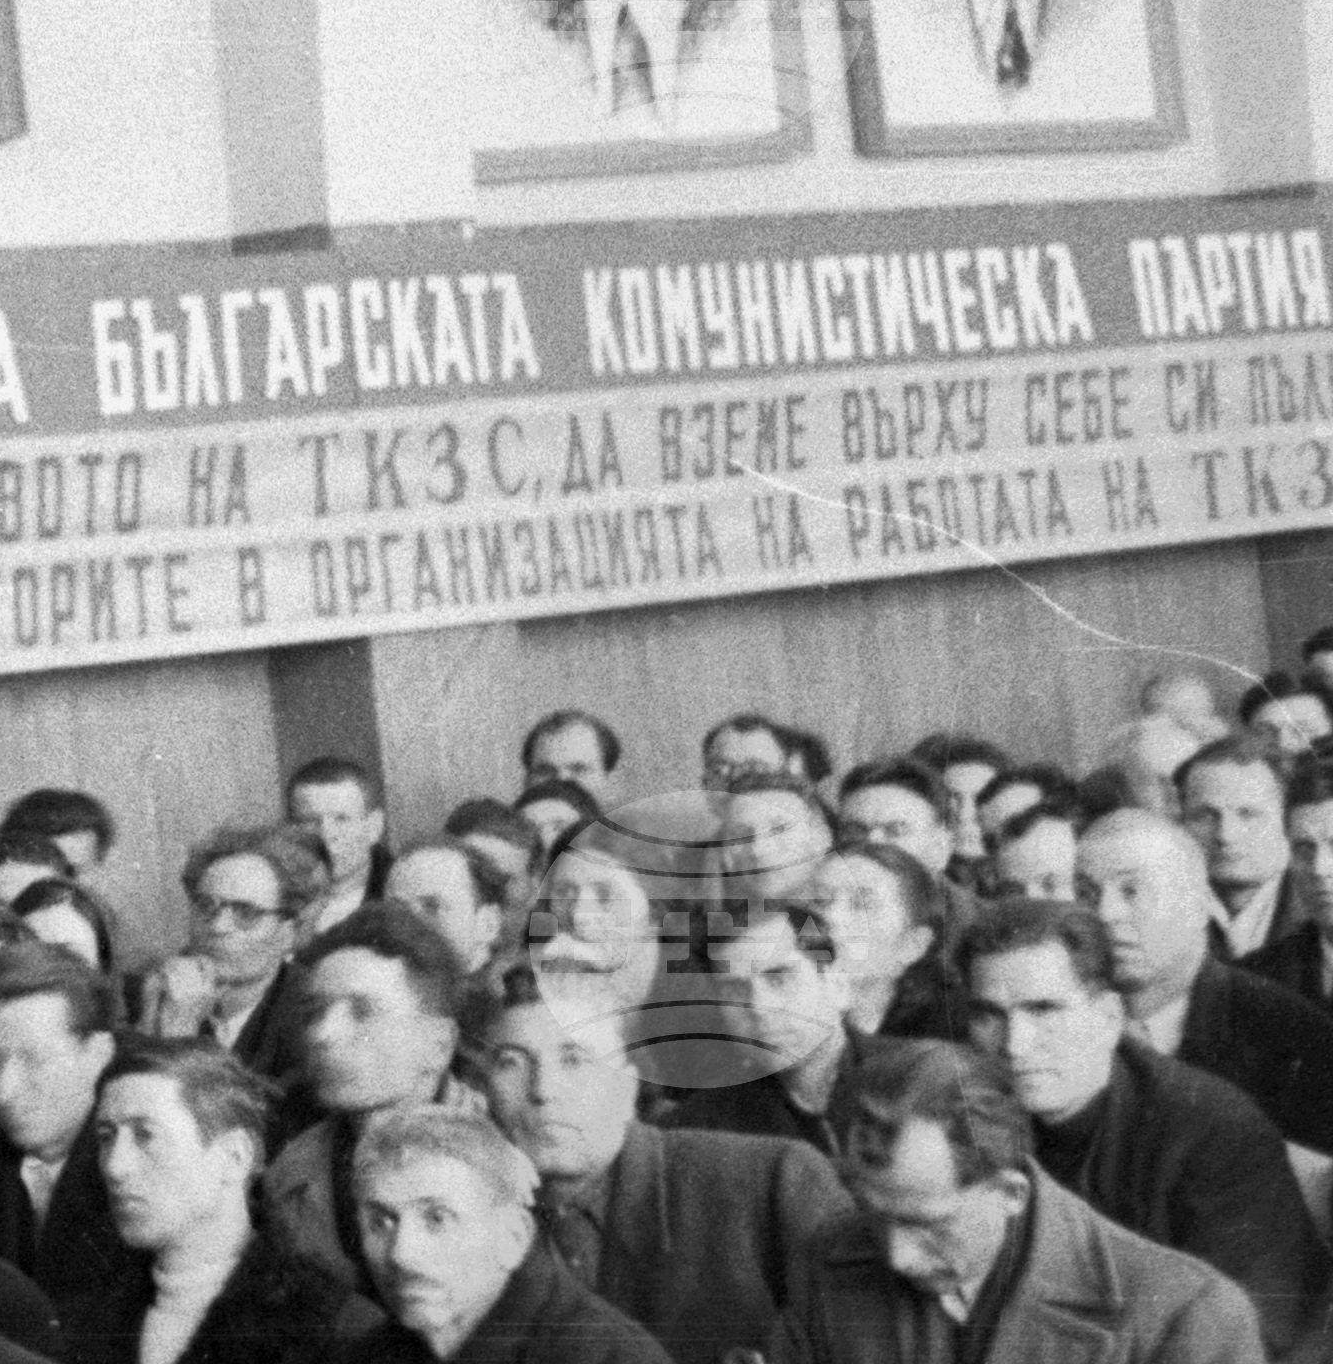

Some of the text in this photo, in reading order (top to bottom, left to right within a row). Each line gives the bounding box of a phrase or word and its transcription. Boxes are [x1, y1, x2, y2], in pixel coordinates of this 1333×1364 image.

[91, 271, 540, 415] БЪЛГАРСКАТА
[583, 242, 1094, 376] КОМУНИСТИЧЕСКА
[1129, 230, 1333, 336] ПАРТИЯ
[187, 444, 253, 530] НА
[561, 407, 624, 497] ДА
[659, 393, 808, 484] ВЗЕМЕ
[841, 376, 989, 465] ВЪРХУ
[1024, 365, 1134, 447] СЕБЕ
[1165, 358, 1220, 435] СИ
[1246, 349, 1333, 426] ПЪЛ
[237, 547, 266, 626] В
[310, 502, 723, 619] ОРГАНИЗАЦИЯТА
[752, 493, 814, 570] НА
[842, 467, 1074, 559] РАБОТАТА
[1102, 455, 1160, 532] НА
